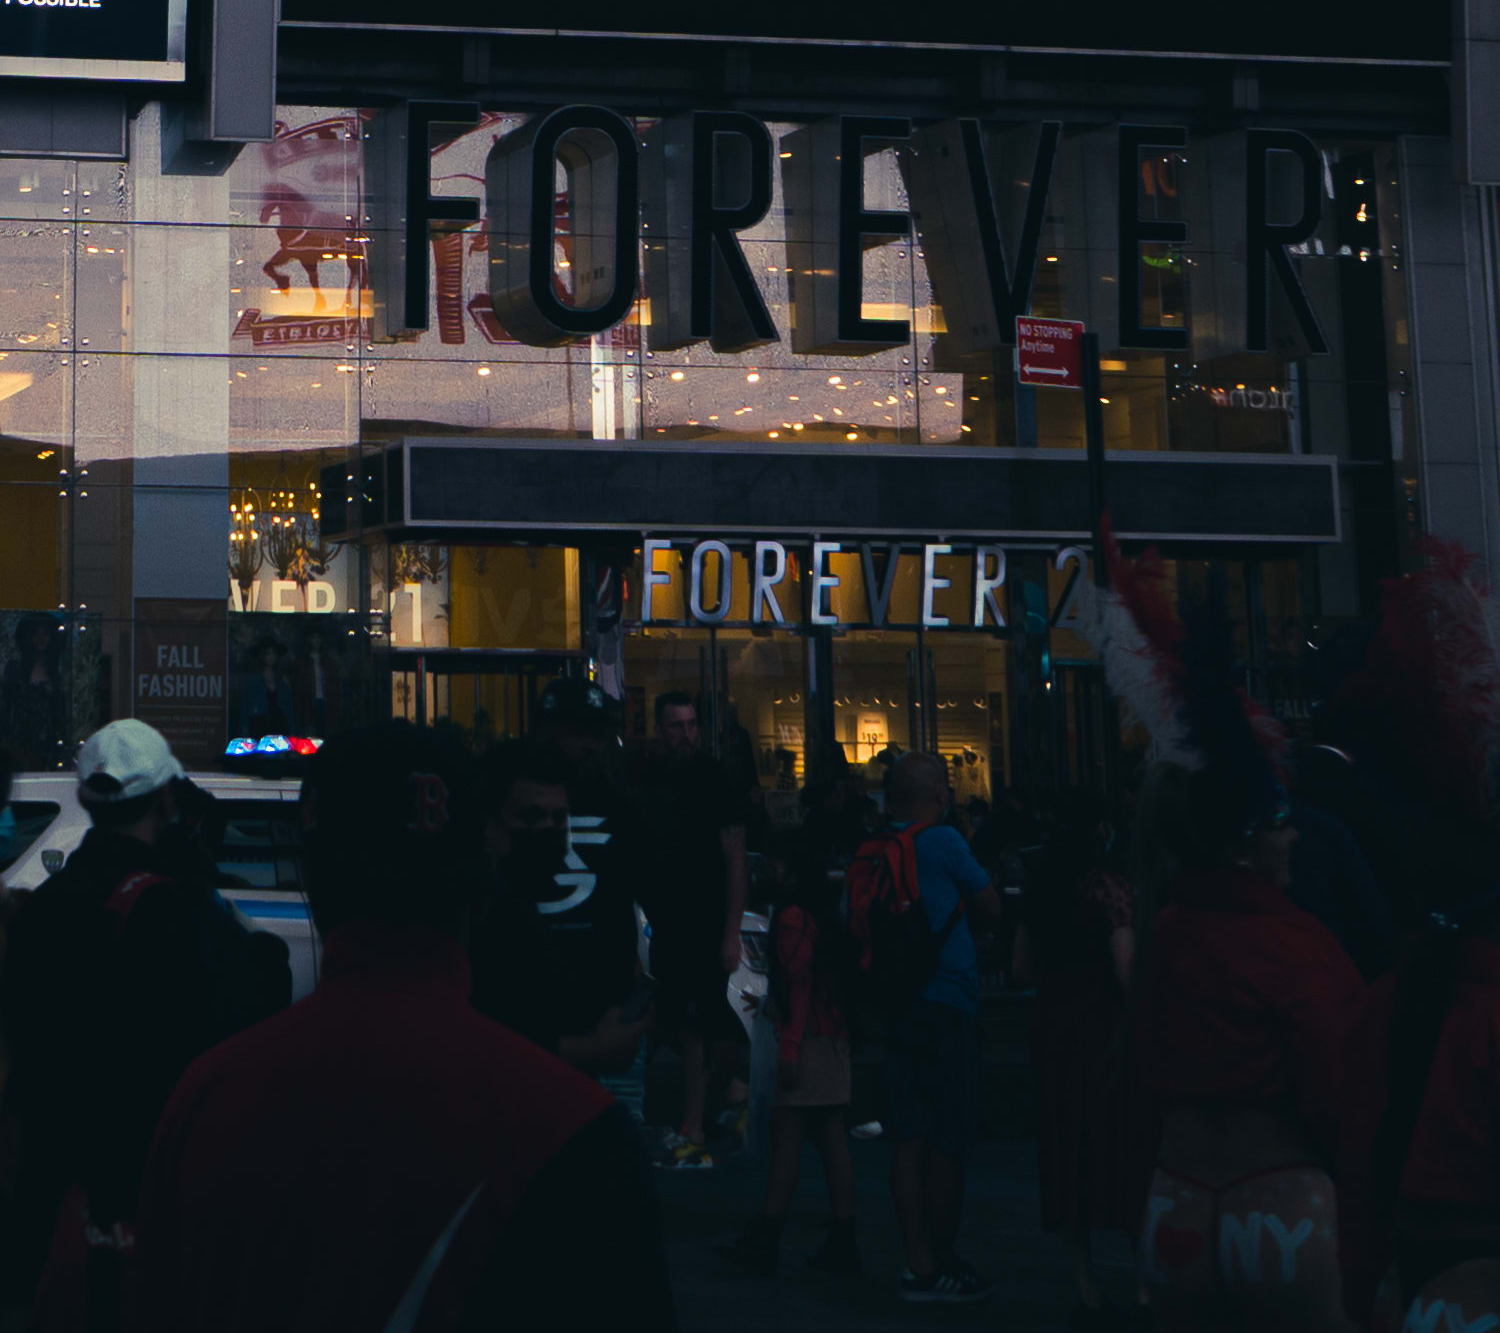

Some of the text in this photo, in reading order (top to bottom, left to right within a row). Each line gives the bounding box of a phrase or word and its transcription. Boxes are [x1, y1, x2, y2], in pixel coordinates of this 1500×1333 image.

[405, 100, 1330, 354] FOREVER
[642, 539, 1008, 627] FOREVER
[157, 645, 204, 669] FALL
[138, 673, 222, 698] FASHION
